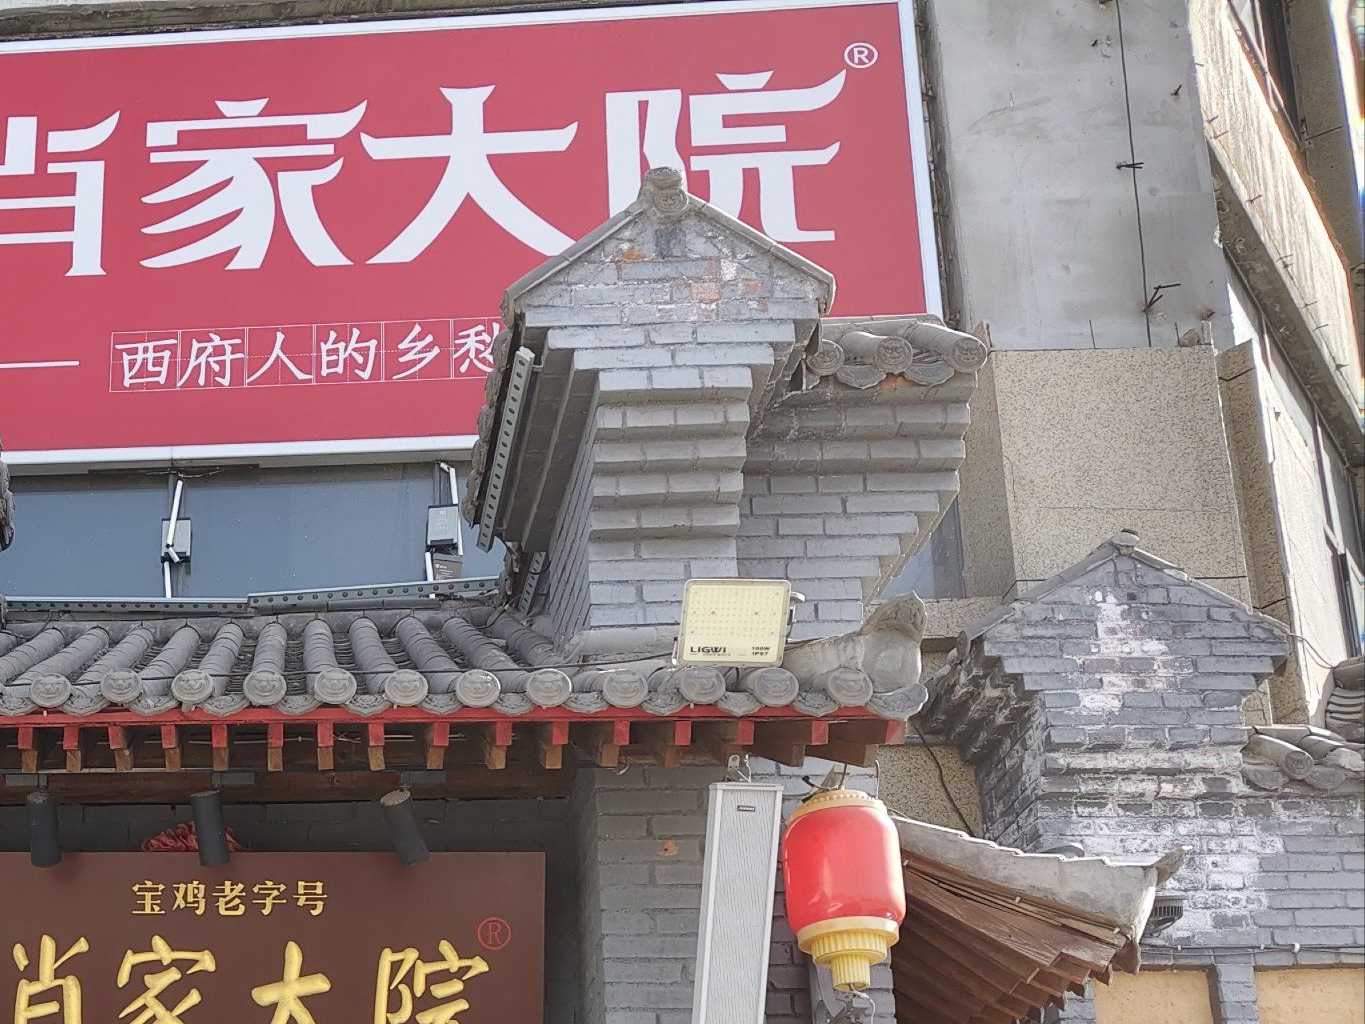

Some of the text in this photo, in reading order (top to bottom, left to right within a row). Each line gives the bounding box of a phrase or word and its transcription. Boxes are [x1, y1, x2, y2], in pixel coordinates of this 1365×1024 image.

[131, 880, 328, 916] 宝鸡老字号
